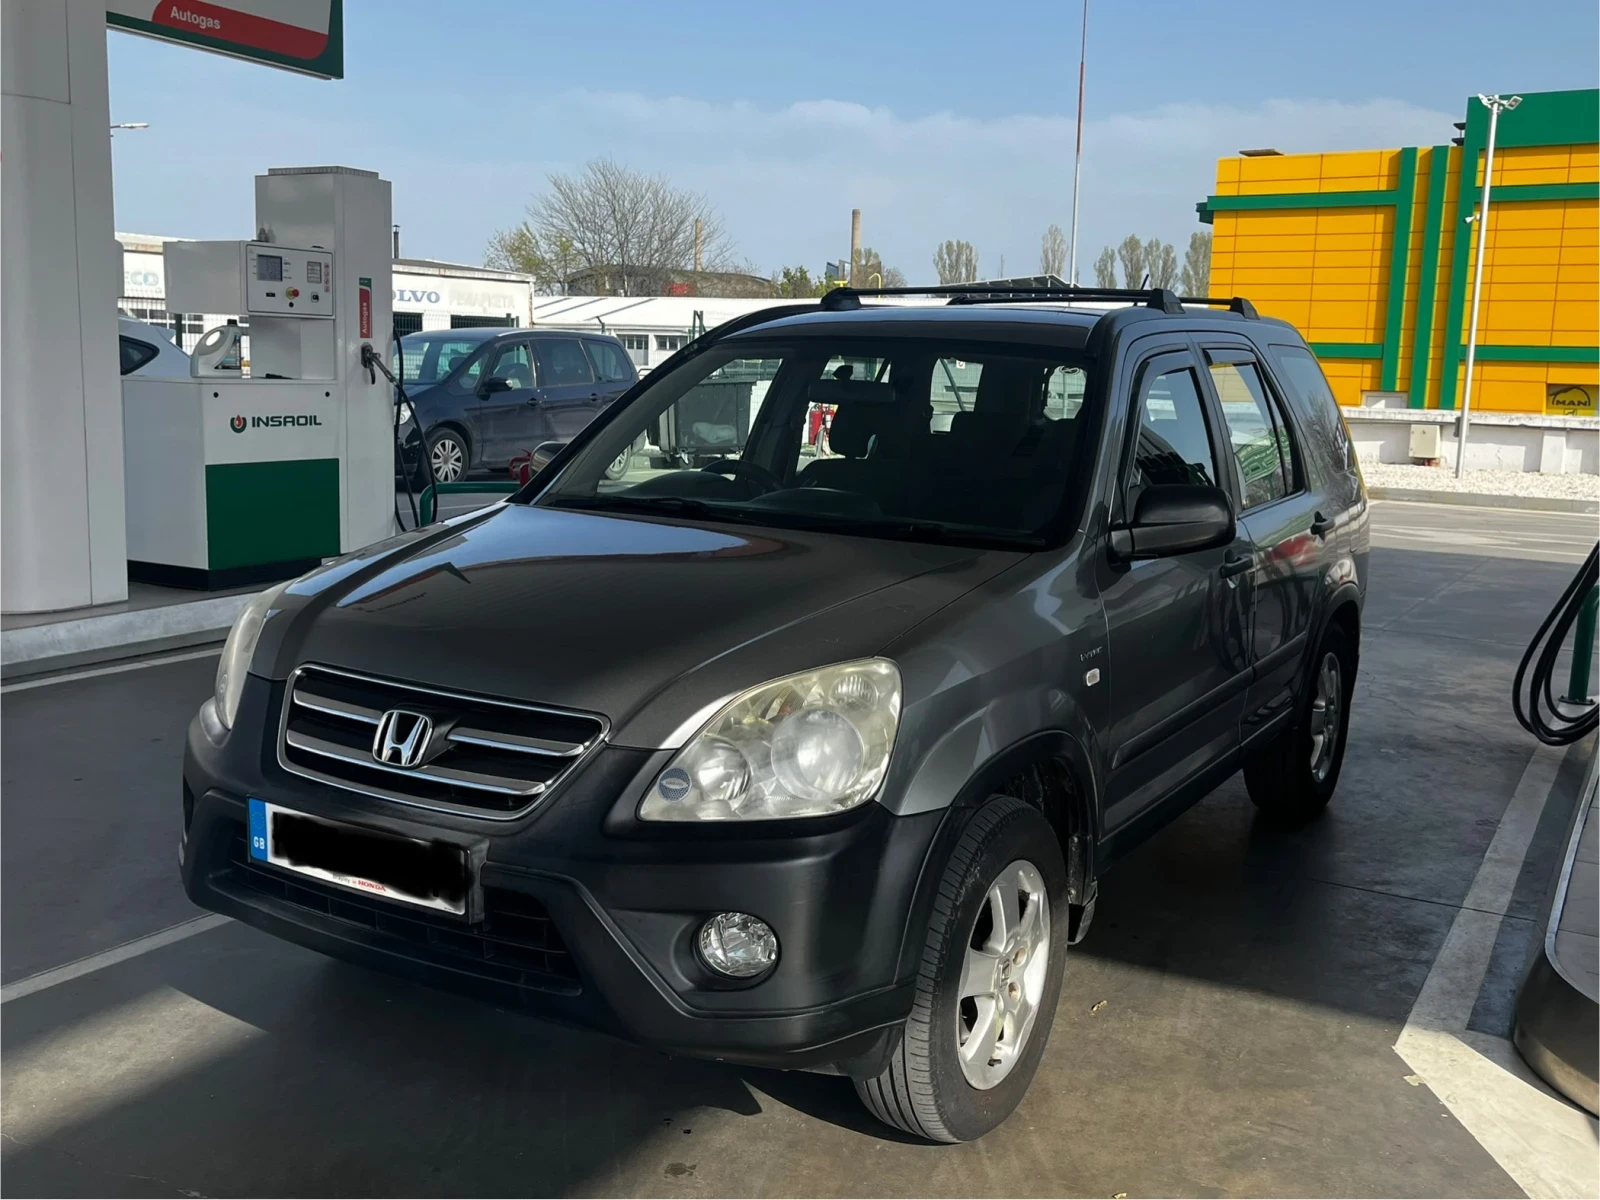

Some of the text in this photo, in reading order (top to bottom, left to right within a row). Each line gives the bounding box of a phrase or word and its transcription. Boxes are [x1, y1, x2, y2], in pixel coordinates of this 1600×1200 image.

[170, 6, 220, 29] Autogas
[252, 415, 322, 427] INSAOIL
[253, 835, 265, 850] GB
[357, 879, 387, 892] HONDA
